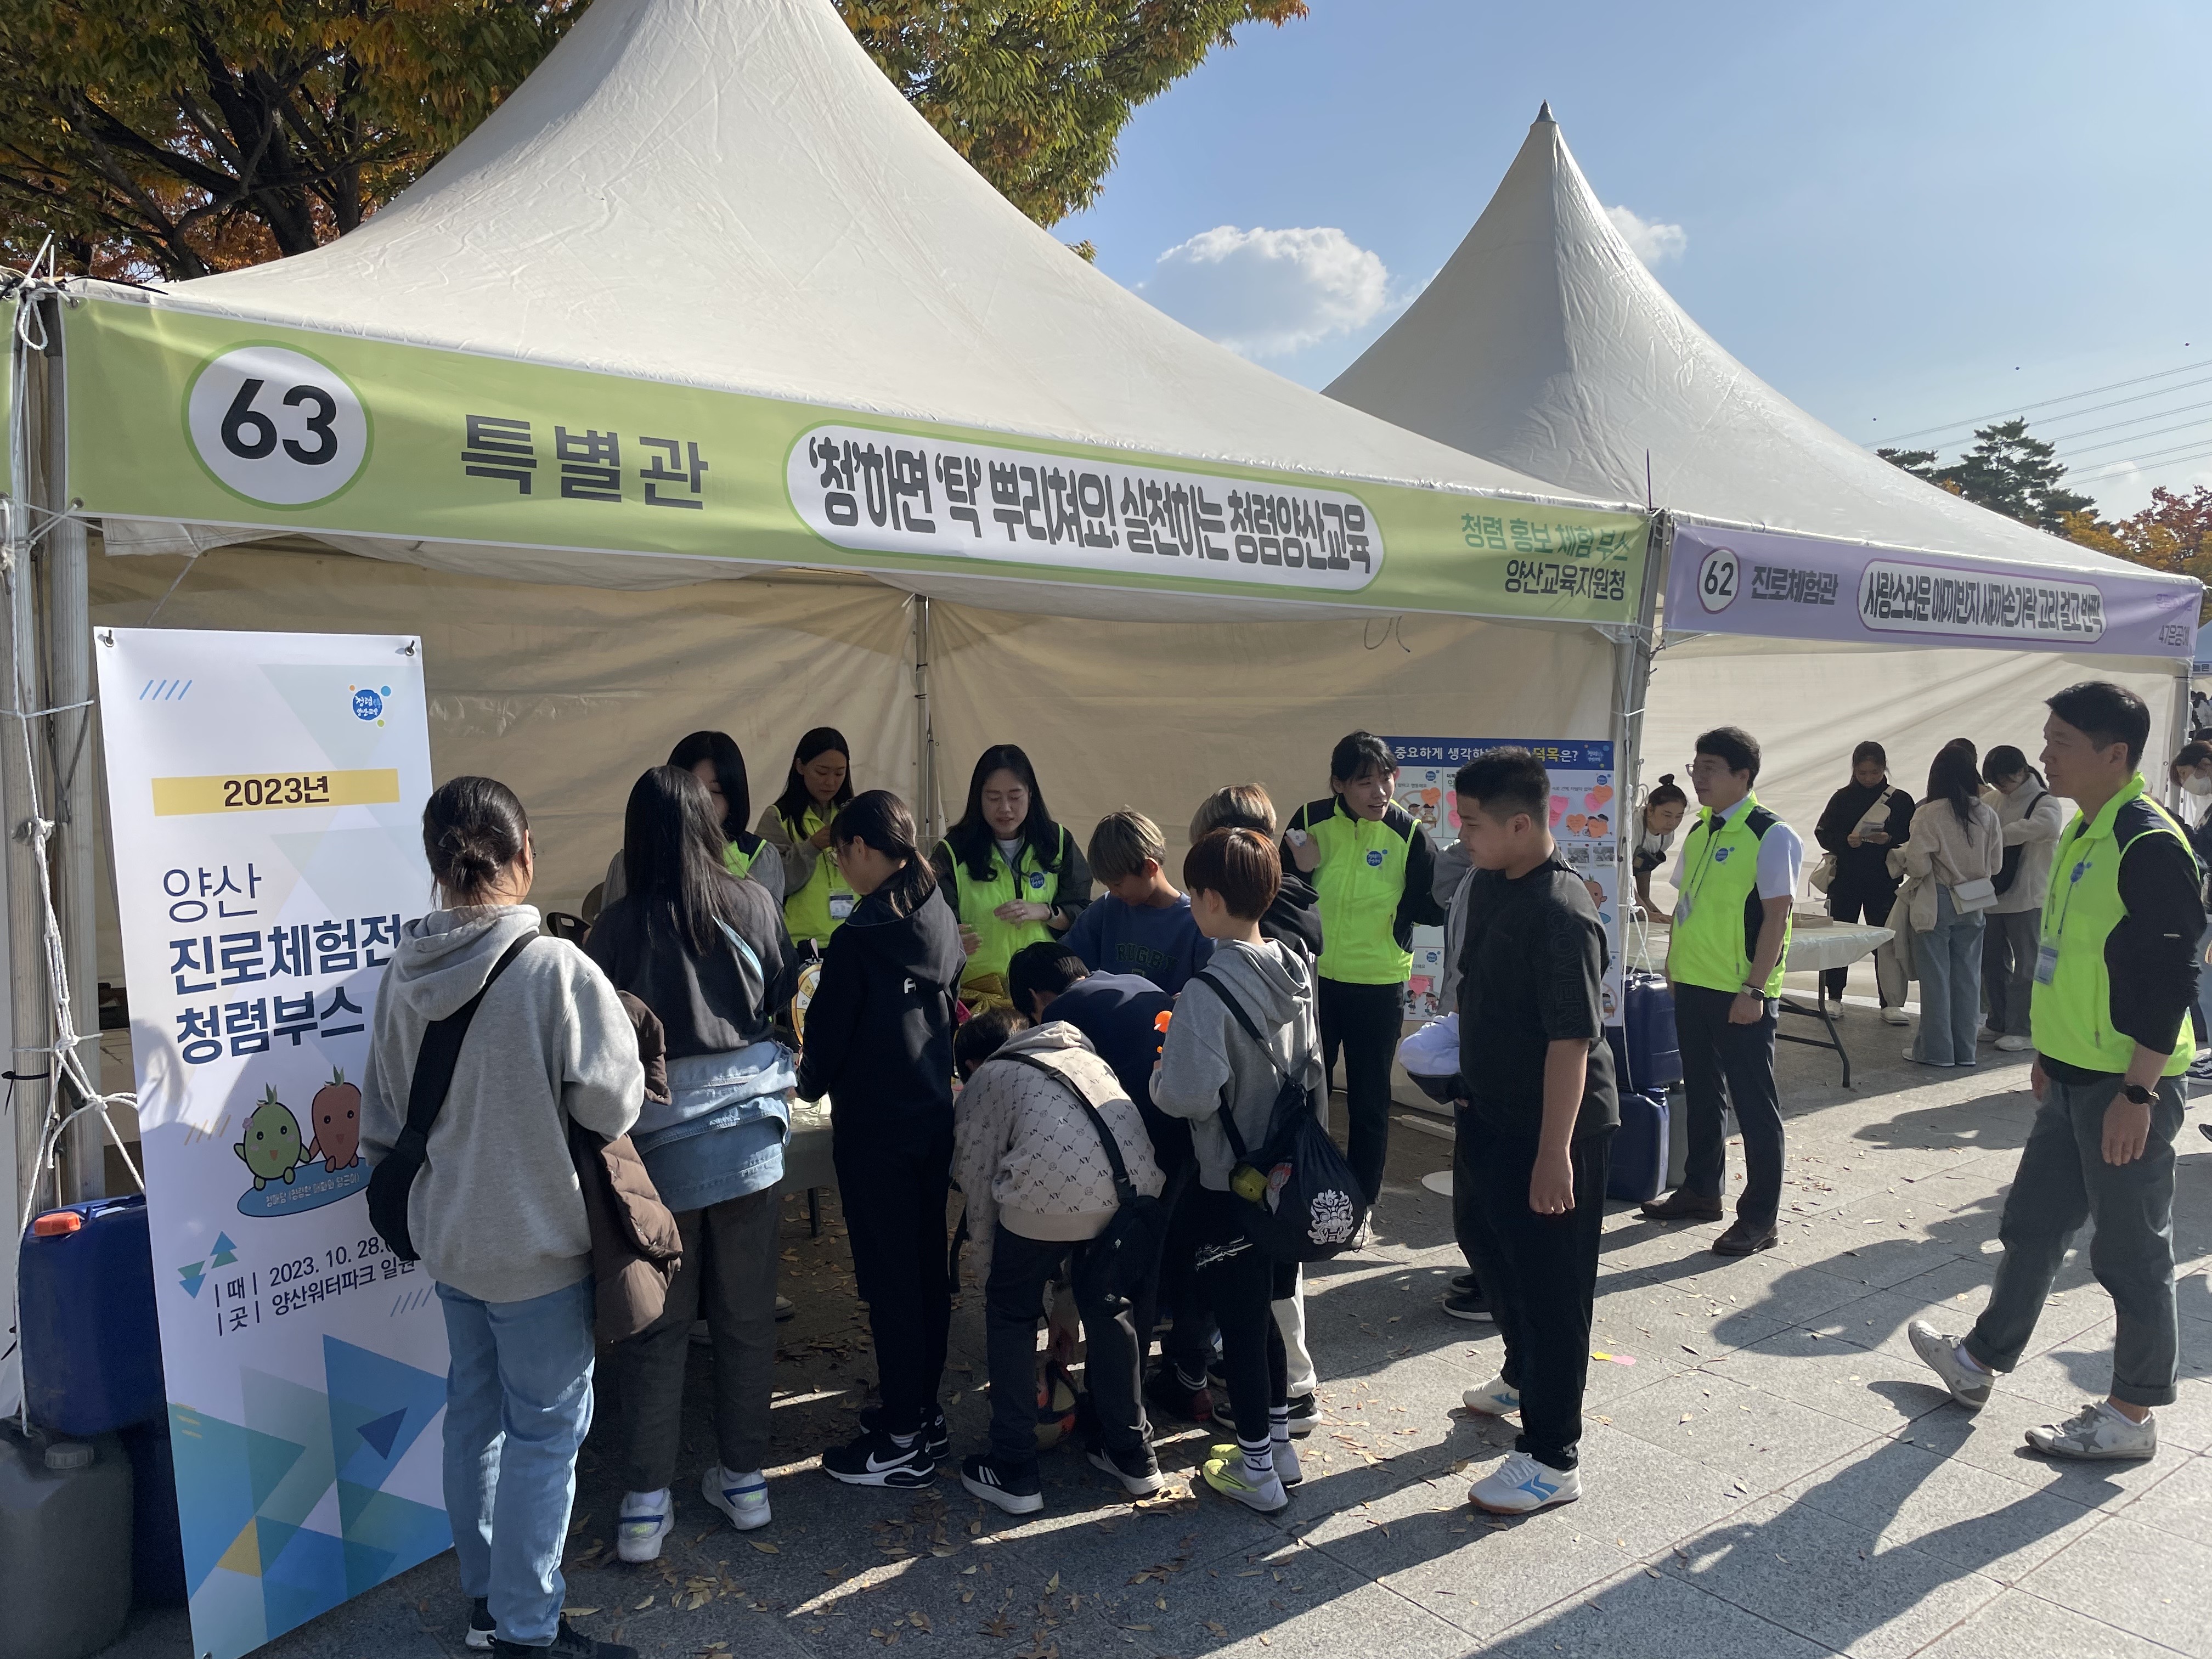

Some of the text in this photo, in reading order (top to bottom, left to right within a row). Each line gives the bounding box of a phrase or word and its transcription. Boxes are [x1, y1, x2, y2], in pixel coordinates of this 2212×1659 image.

[221, 379, 338, 465] 63
[461, 414, 708, 510] 특별관
[989, 460, 1118, 549] 뿌리쳐요!
[1120, 477, 1228, 561] 실천하는
[1229, 489, 1370, 574] 청렴양산교육
[1462, 513, 1506, 550] 청렴
[1509, 518, 1553, 554] 홍보
[1505, 560, 1625, 601] 양산교육지원청
[1705, 561, 1734, 596] 62
[1751, 566, 1838, 606] 진로체험관
[1864, 571, 1931, 621] 사랑스러운
[1980, 583, 2037, 629] 새끼손가락
[2038, 589, 2059, 630] 고리
[2061, 591, 2081, 631] 걸고
[1394, 746, 1490, 760] 중요하게 생각하
[223, 775, 330, 806] 2023년
[163, 863, 261, 923] 양산
[169, 914, 401, 995] 진로체험전
[1115, 942, 1181, 971] RUGBY
[176, 986, 365, 1065] 청렴부스
[269, 1257, 319, 1286] 2023.
[326, 1246, 352, 1267] 10.
[272, 1265, 376, 1316] 양산워터파크
